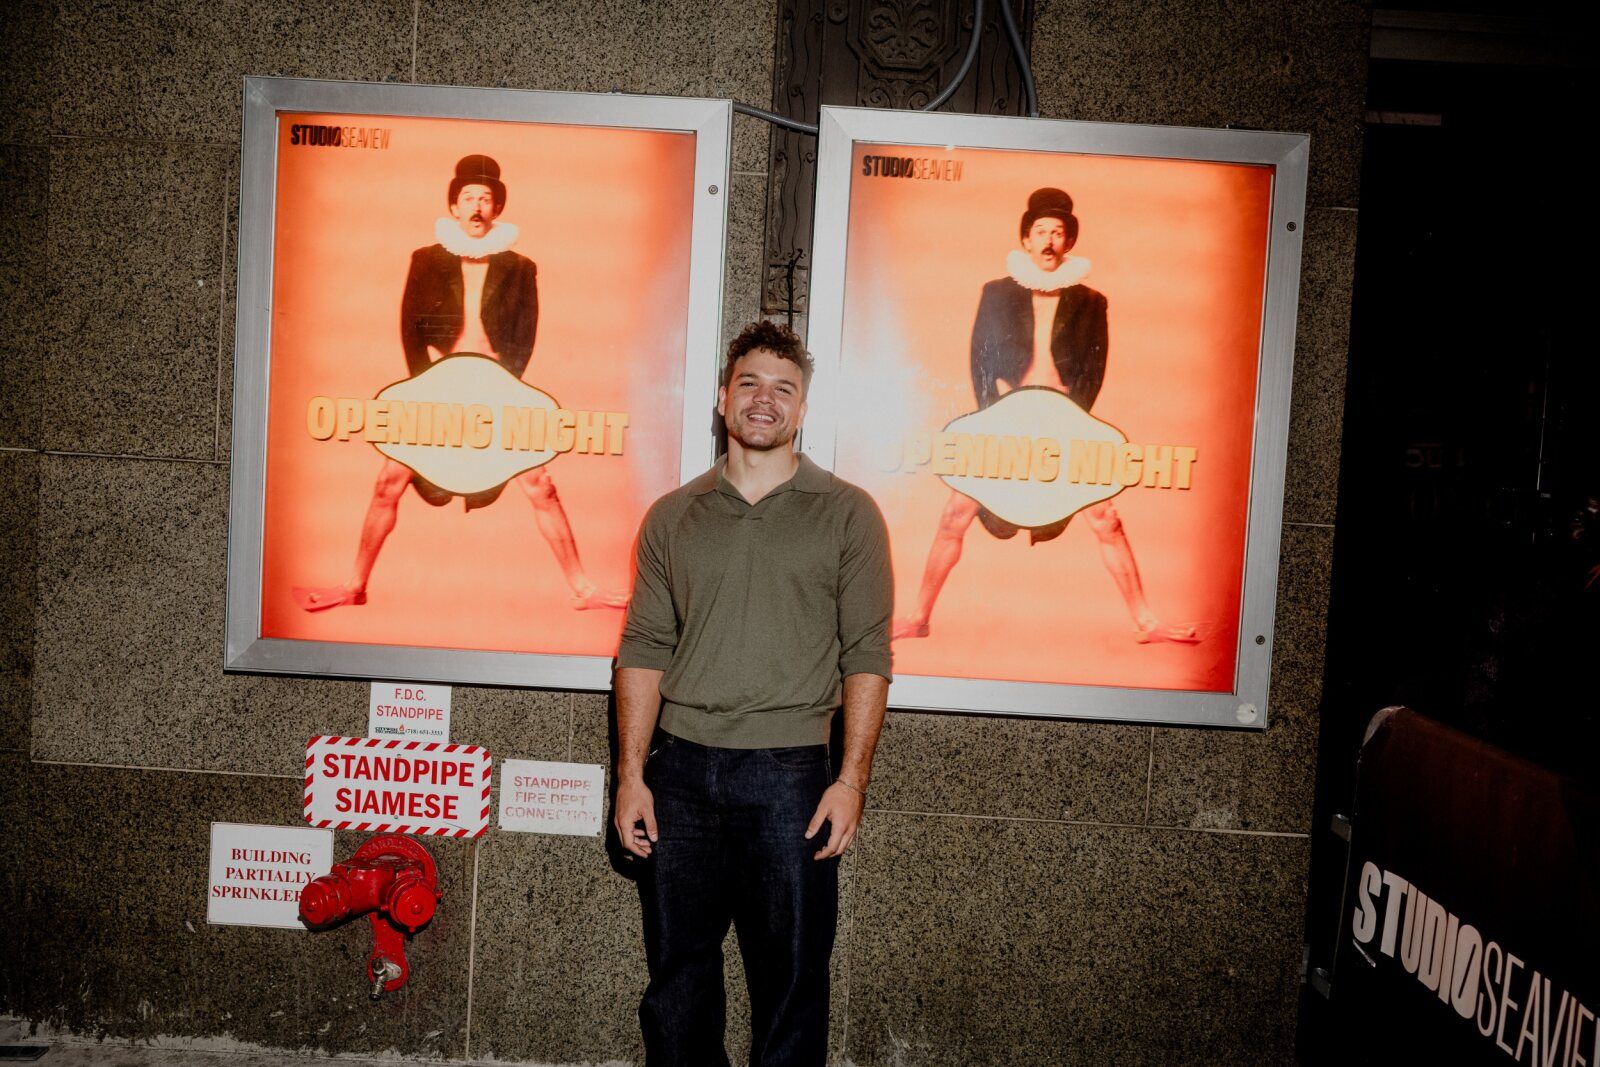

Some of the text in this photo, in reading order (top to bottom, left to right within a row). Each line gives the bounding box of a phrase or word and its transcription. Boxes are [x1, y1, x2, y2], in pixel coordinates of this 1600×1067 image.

[306, 396, 630, 456] OPENING NIGHT
[877, 431, 1198, 490] PENING NIGHT
[394, 687, 427, 701] F.D.C.
[376, 704, 444, 721] STANDPIPE
[322, 753, 475, 787] STANDPIPE
[513, 775, 592, 790] STANDPIPE
[335, 788, 459, 820] SIAMESE
[514, 791, 588, 806] FIRE DEPT
[231, 848, 311, 865] BUILDING
[225, 867, 316, 884] PARTIALLY
[1352, 861, 1600, 1067] STUDIOSEAVIE
